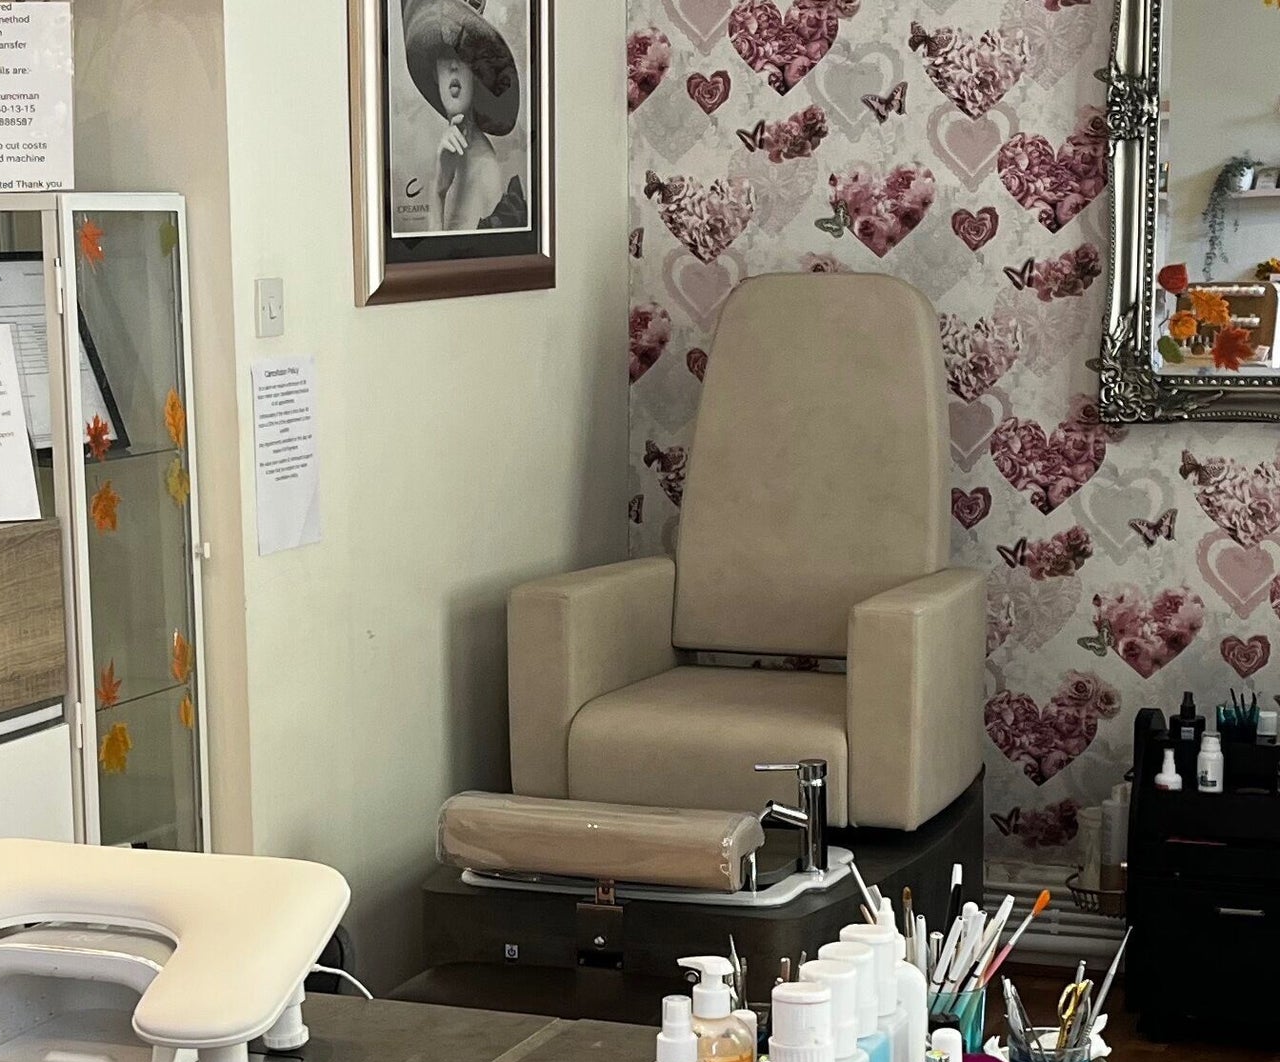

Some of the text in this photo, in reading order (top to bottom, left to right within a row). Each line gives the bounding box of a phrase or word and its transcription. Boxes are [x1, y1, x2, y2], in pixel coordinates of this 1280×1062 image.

[5, 142, 20, 150] cut
[22, 142, 47, 150] costs
[6, 154, 45, 163] machine
[16, 180, 43, 189] Thank
[46, 180, 62, 189] you
